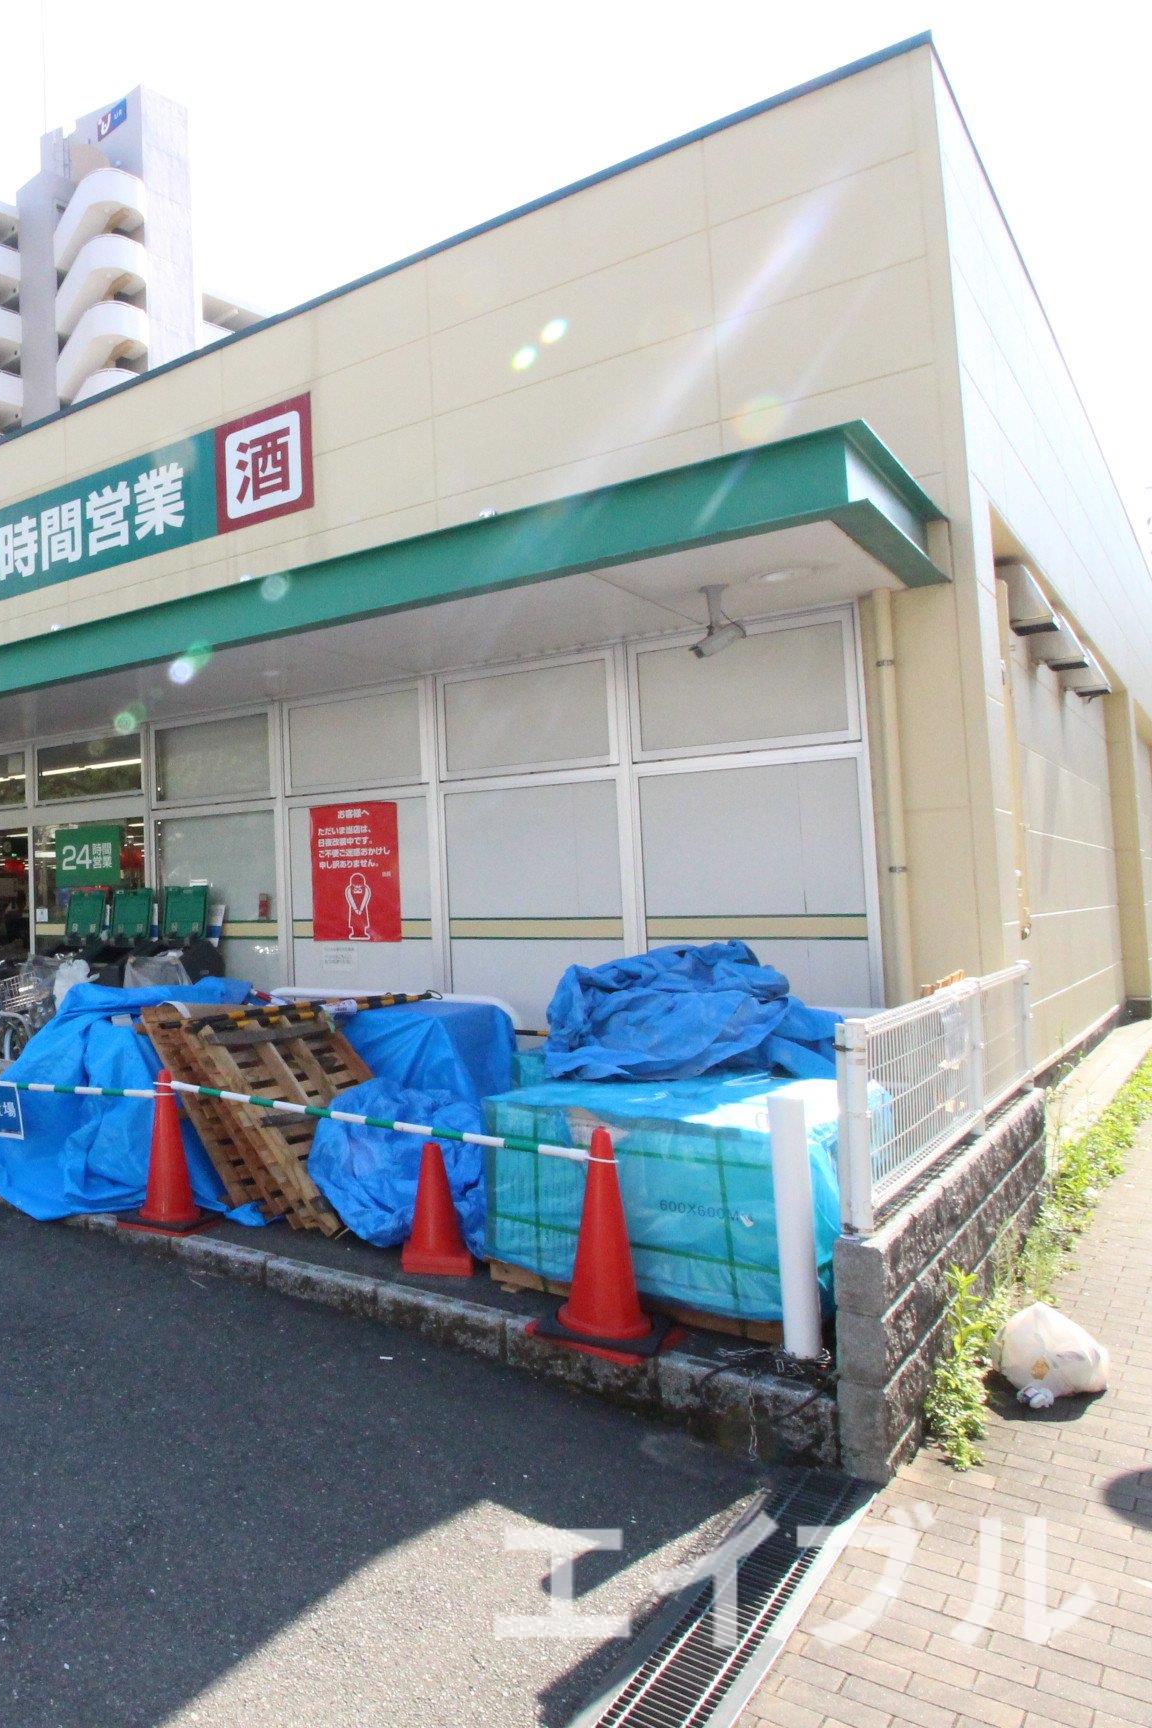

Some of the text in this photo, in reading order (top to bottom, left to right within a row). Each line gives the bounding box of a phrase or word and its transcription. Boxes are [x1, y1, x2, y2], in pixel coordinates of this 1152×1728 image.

[234, 425, 294, 504] 酒
[337, 808, 370, 819] お客様へ
